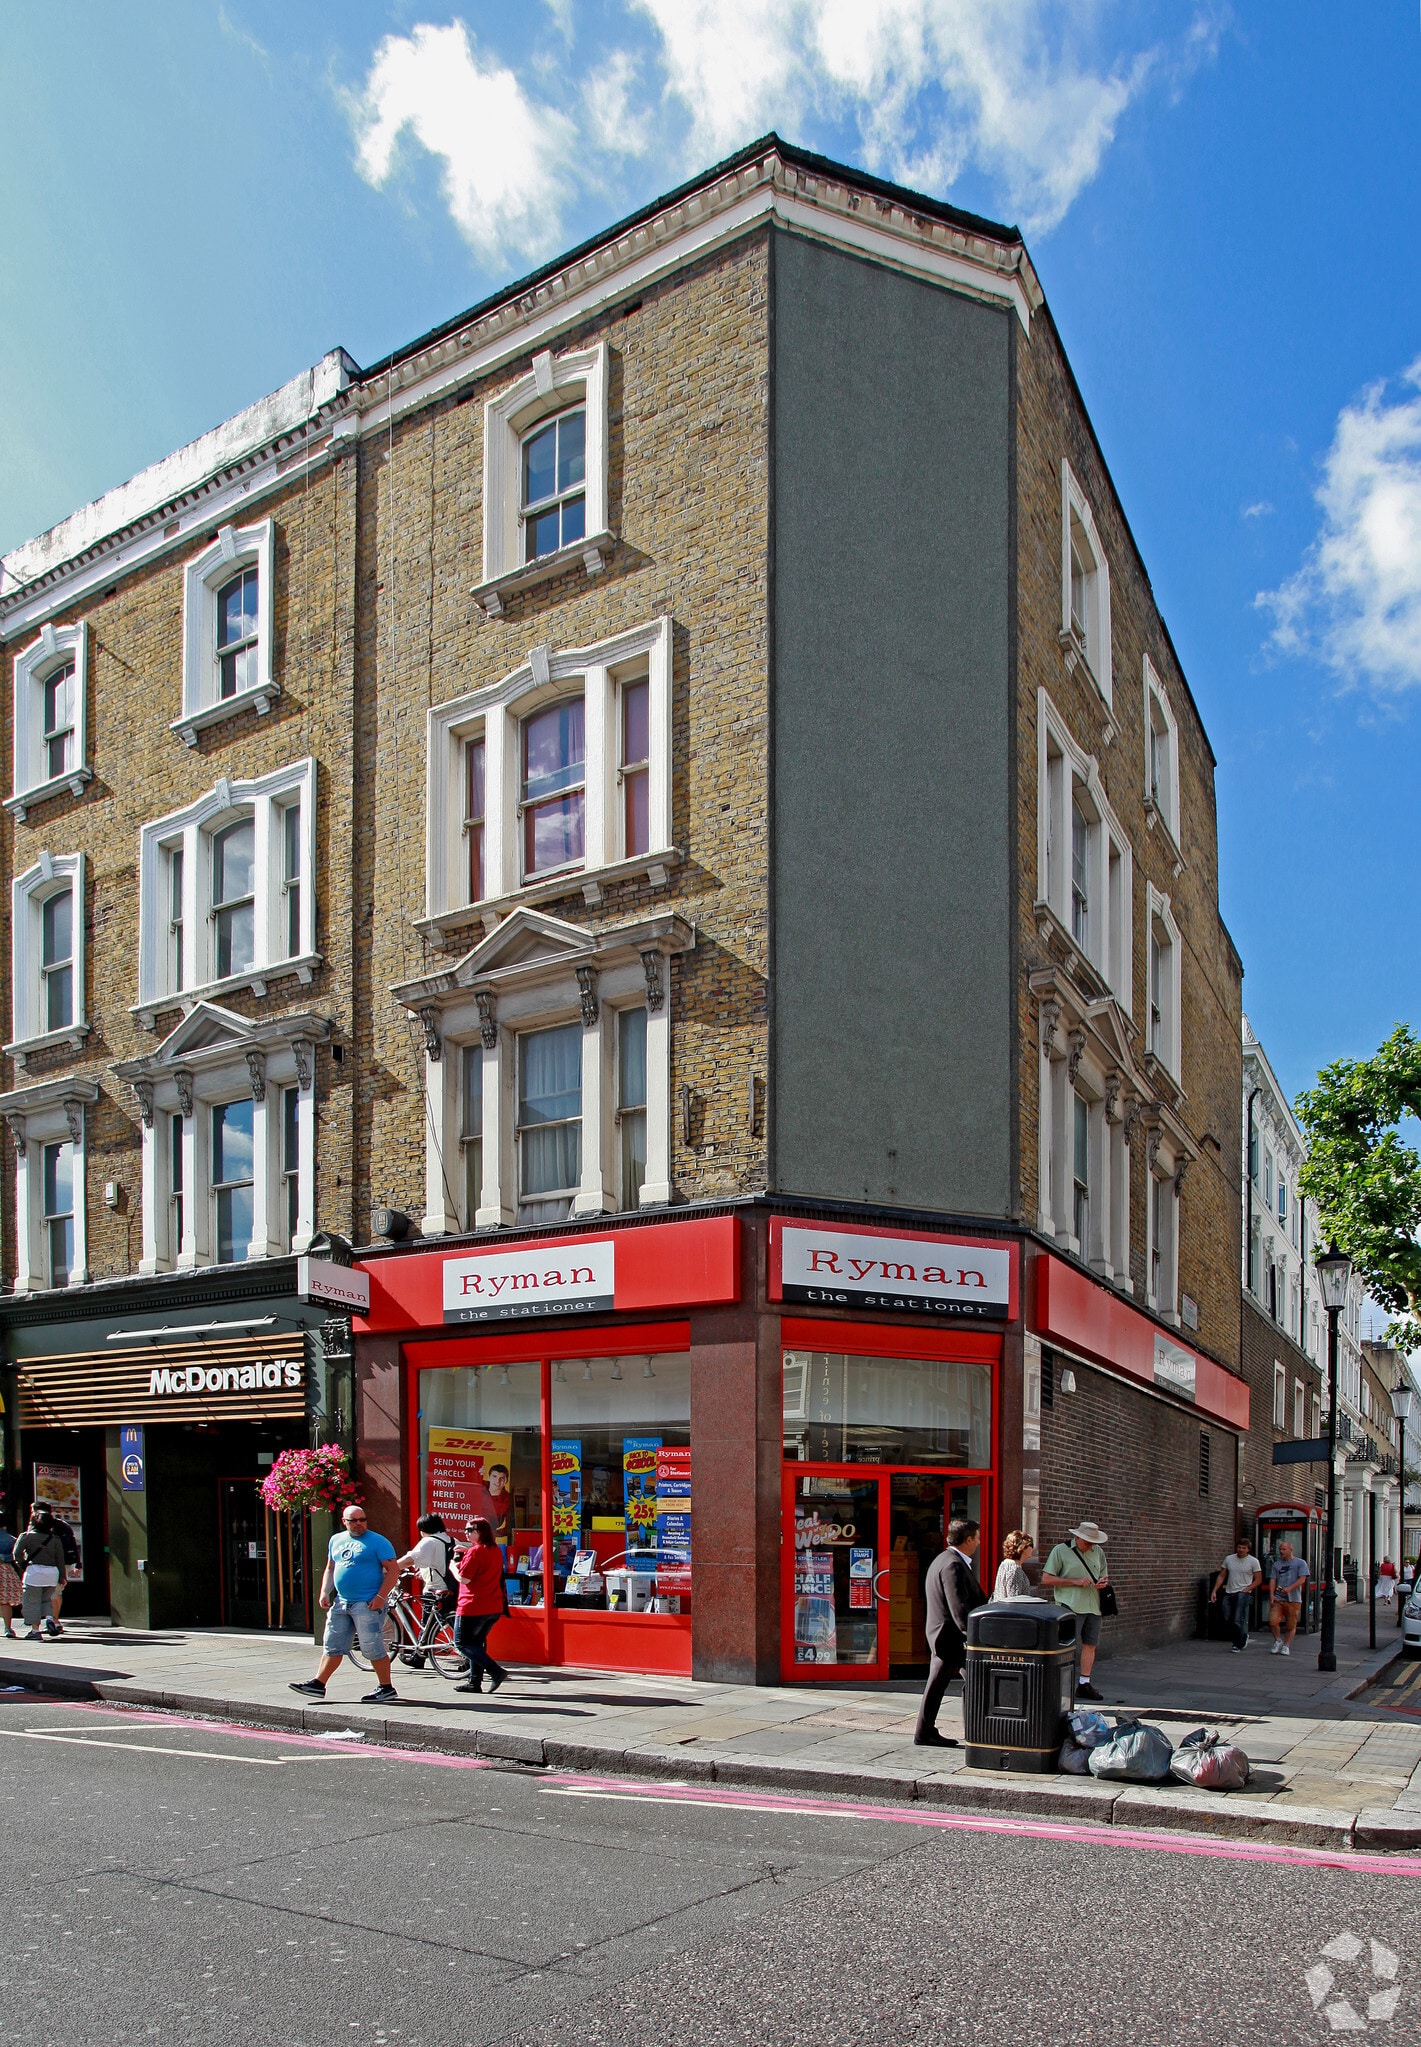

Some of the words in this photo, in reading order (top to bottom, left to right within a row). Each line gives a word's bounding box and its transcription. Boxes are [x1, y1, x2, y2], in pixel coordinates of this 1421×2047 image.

[806, 1249, 988, 1288] Ryman
[459, 1266, 597, 1297] Ryman
[311, 1280, 367, 1302] Ryman
[806, 1290, 848, 1302] the
[864, 1296, 988, 1315] stationer
[459, 1310, 489, 1320] the
[499, 1301, 597, 1317] stationer
[1158, 1348, 1192, 1381] Ryman
[149, 1359, 301, 1395] McDonald's
[443, 1437, 498, 1452] DHL
[658, 1450, 691, 1458] Ryman
[433, 1457, 454, 1467] SEND
[455, 1459, 476, 1468] YOUR
[626, 1456, 657, 1470] SCHOOL
[39, 1466, 49, 1474] 20
[433, 1468, 466, 1478] PARCELS
[433, 1479, 456, 1488] FROM
[432, 1490, 454, 1499] HERE
[456, 1491, 466, 1499] TO
[432, 1500, 459, 1509] THERE
[460, 1502, 472, 1511] OR
[633, 1504, 655, 1519] 25%
[554, 1515, 561, 1526] 3
[566, 1515, 573, 1526] 2
[795, 1511, 819, 1531] eal
[795, 1573, 831, 1583] HALF
[795, 1583, 831, 1594] PRICE
[797, 1649, 831, 1661] £4.99
[990, 1654, 1025, 1662] LITTER
